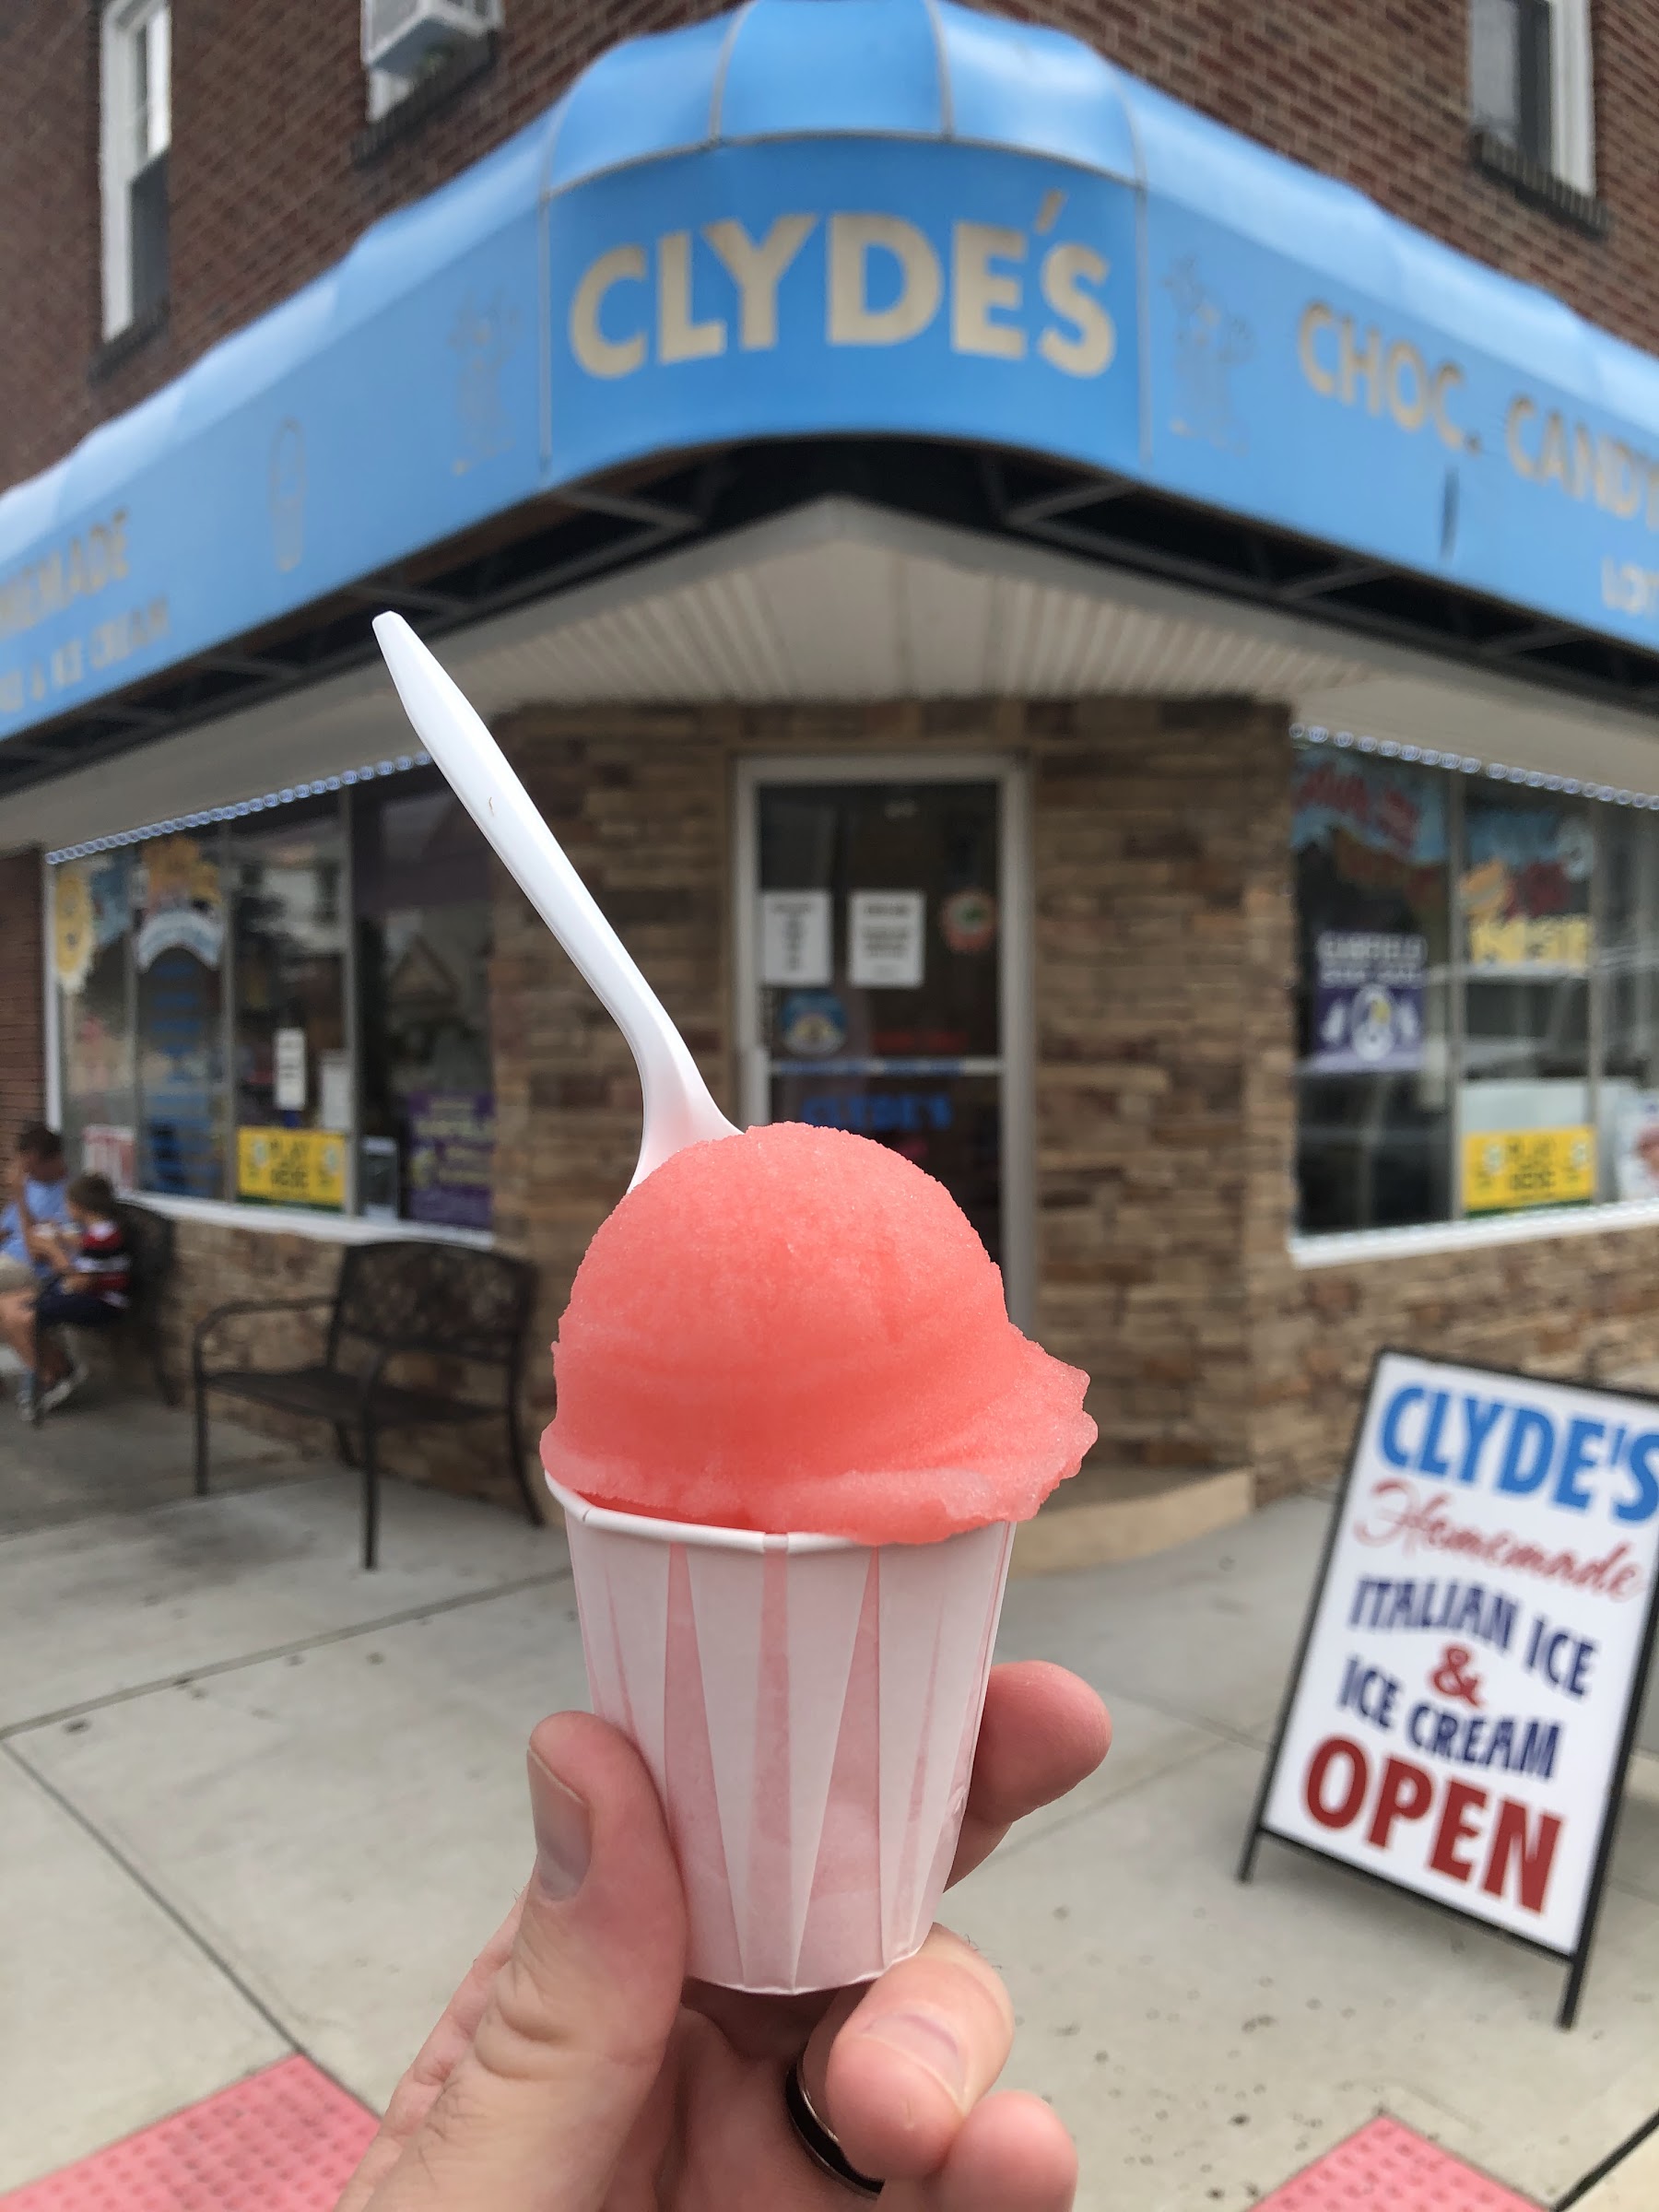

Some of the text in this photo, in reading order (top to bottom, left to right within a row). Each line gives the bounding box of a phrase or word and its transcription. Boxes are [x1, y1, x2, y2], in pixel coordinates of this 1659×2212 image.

[568, 188, 1117, 379] CLYDE'S
[1297, 300, 1481, 457] CHOC.
[1382, 1384, 1659, 1524] CLYDE'S
[1352, 1476, 1642, 1605] Homemade
[1349, 1577, 1606, 1698] ITALIAN ICE
[1432, 1645, 1481, 1709] &
[1339, 1656, 1560, 1782] ICE CREAM
[1304, 1737, 1563, 1916] OPEN
